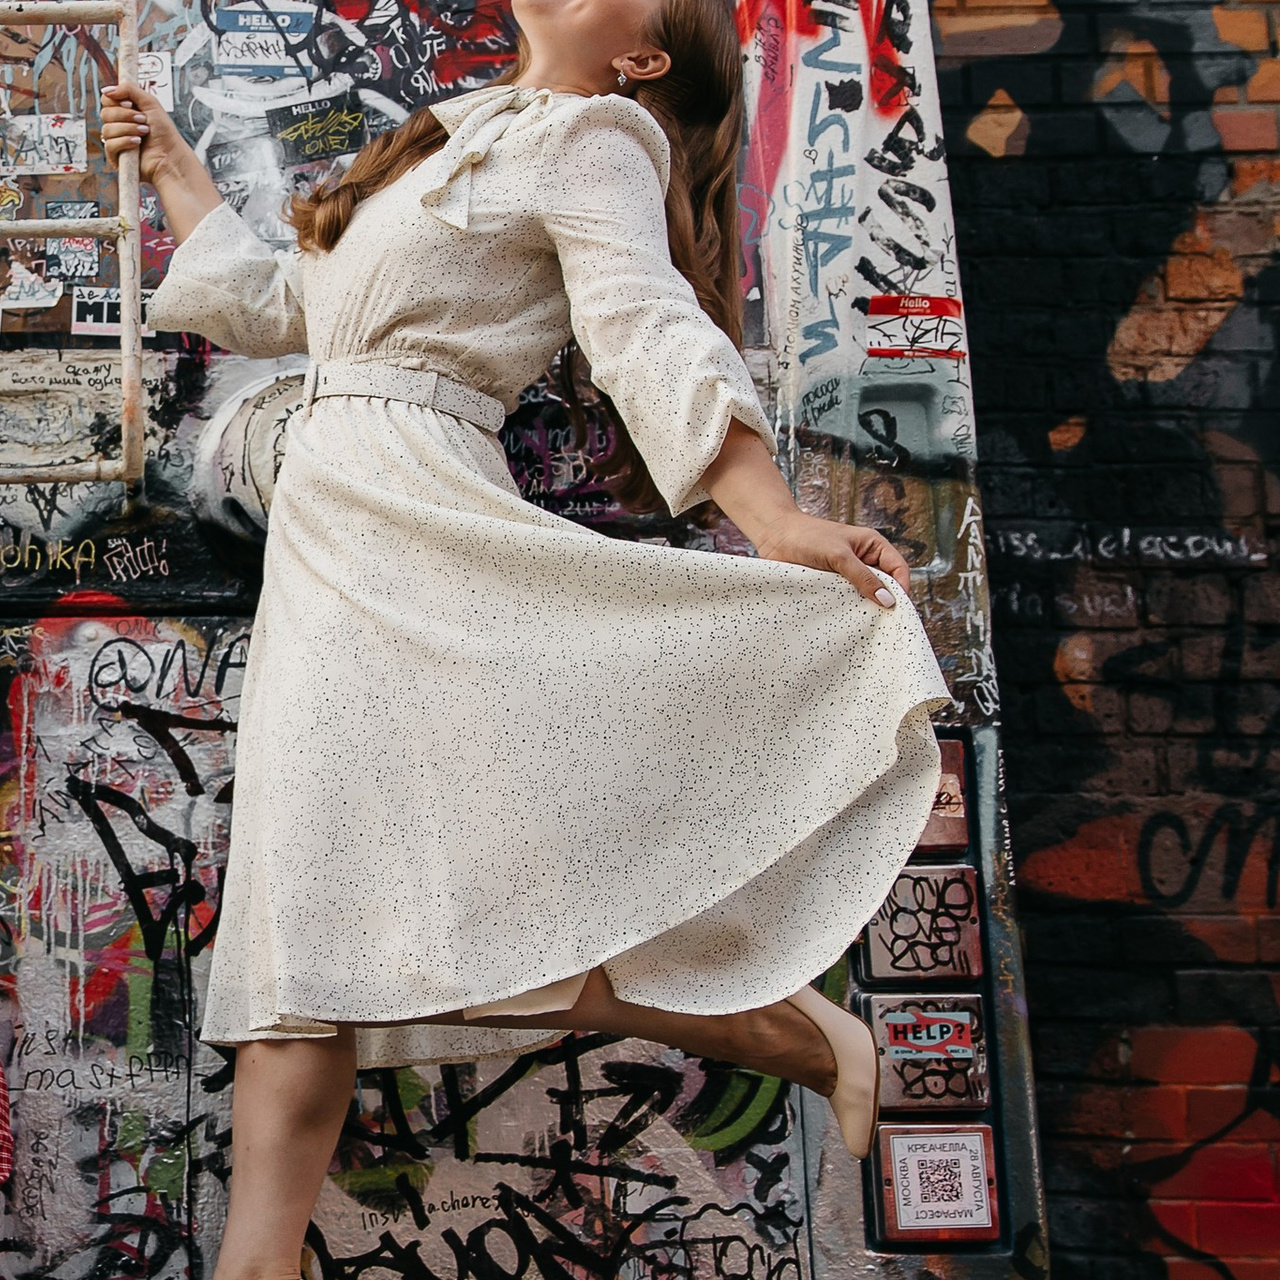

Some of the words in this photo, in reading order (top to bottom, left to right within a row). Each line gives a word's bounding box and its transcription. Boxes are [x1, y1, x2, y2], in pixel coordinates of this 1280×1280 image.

[238, 14, 292, 28] HELO
[291, 100, 332, 116] HELLO
[899, 297, 930, 309] Hello
[891, 1022, 967, 1042] HELP?
[907, 1141, 970, 1153] КРЕАЧЕЛЛА
[898, 1157, 912, 1207] МОСКВА
[970, 1163, 985, 1212] АВГУСТА
[914, 1209, 975, 1221] МАРАФЕСТ
